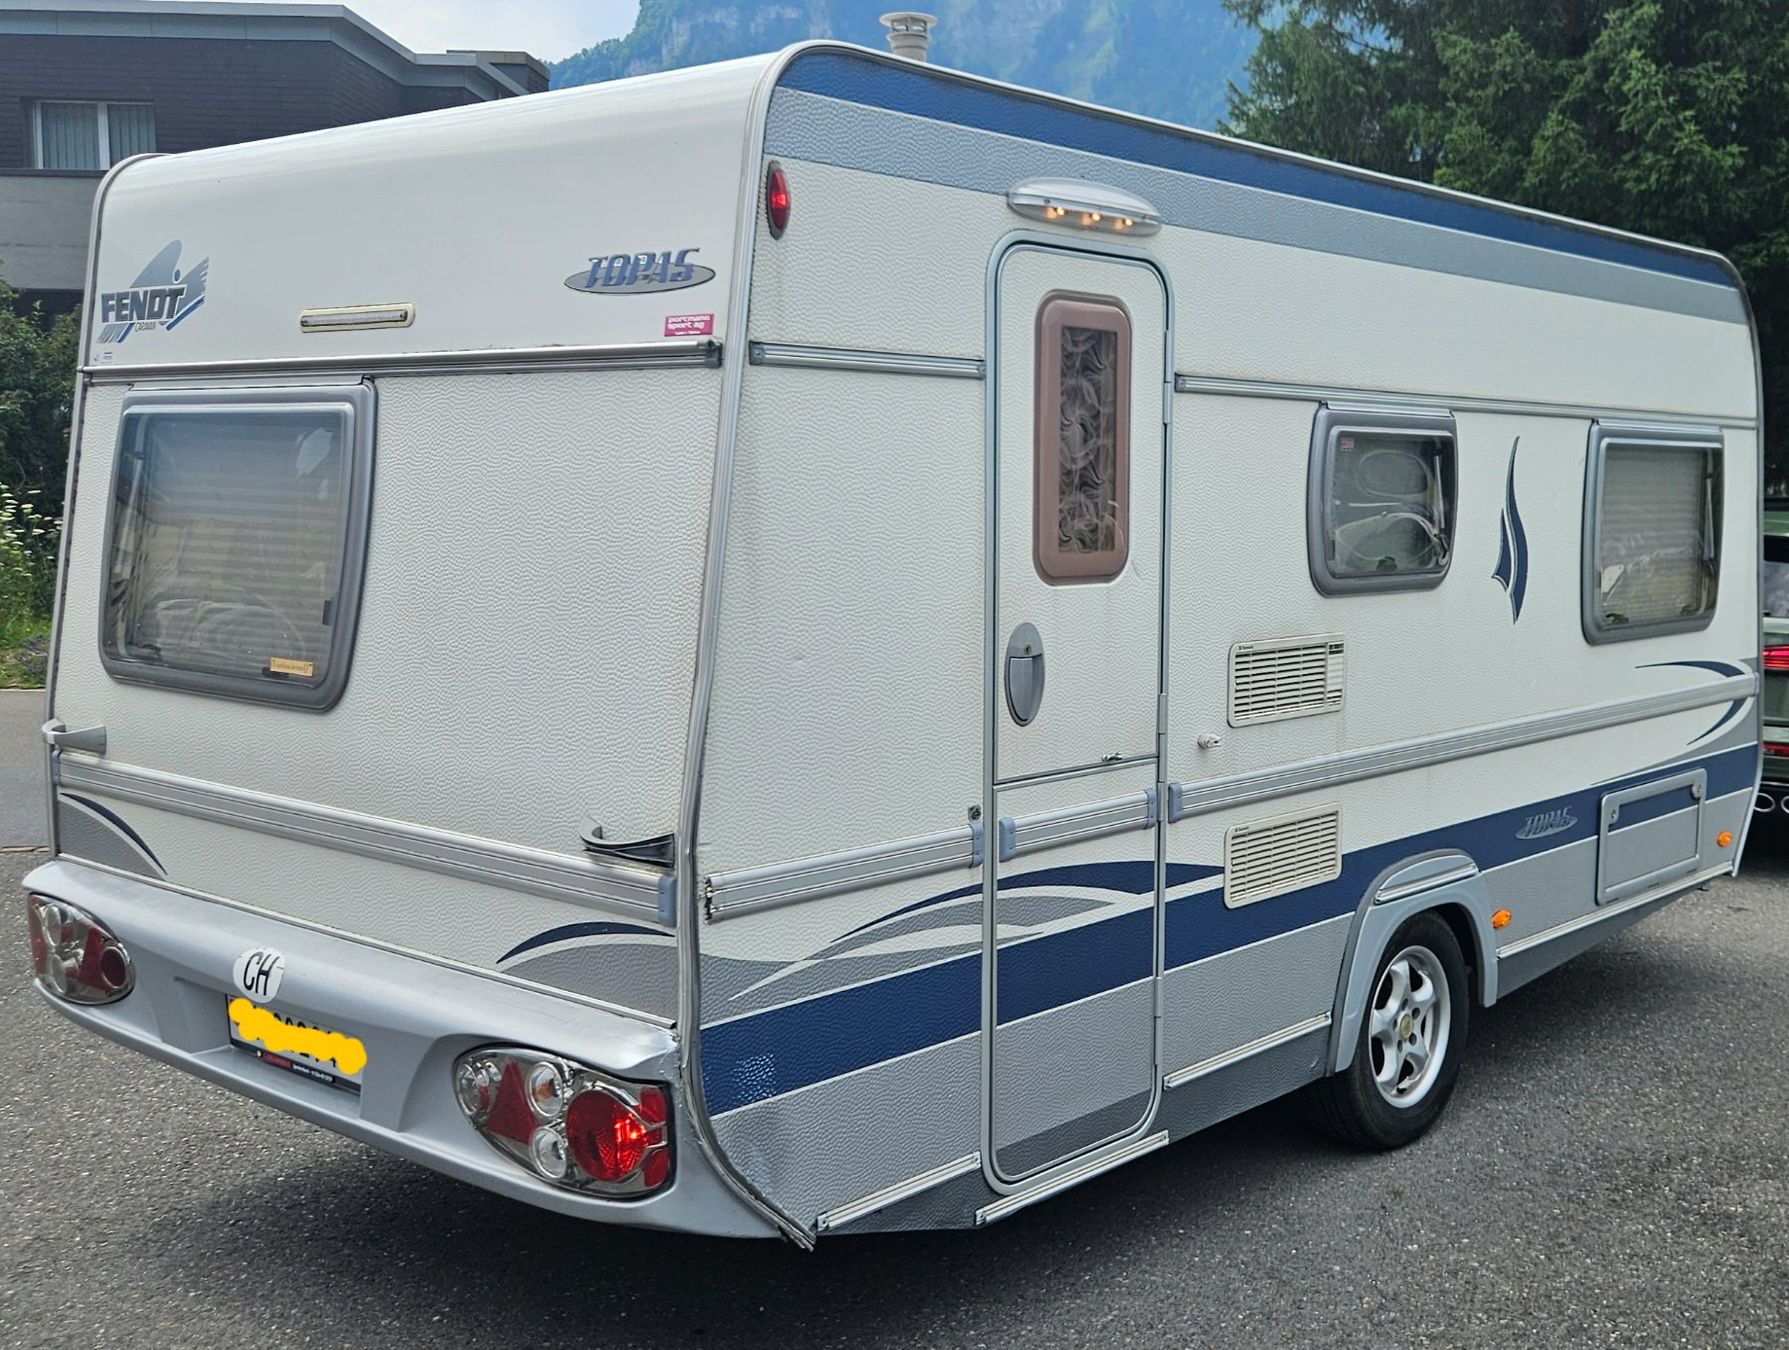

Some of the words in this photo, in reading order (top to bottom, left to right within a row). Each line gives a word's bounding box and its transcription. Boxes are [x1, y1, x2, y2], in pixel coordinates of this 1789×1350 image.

[584, 248, 701, 289] TOPAS
[101, 286, 186, 323] FENDT
[243, 951, 280, 996] CH
